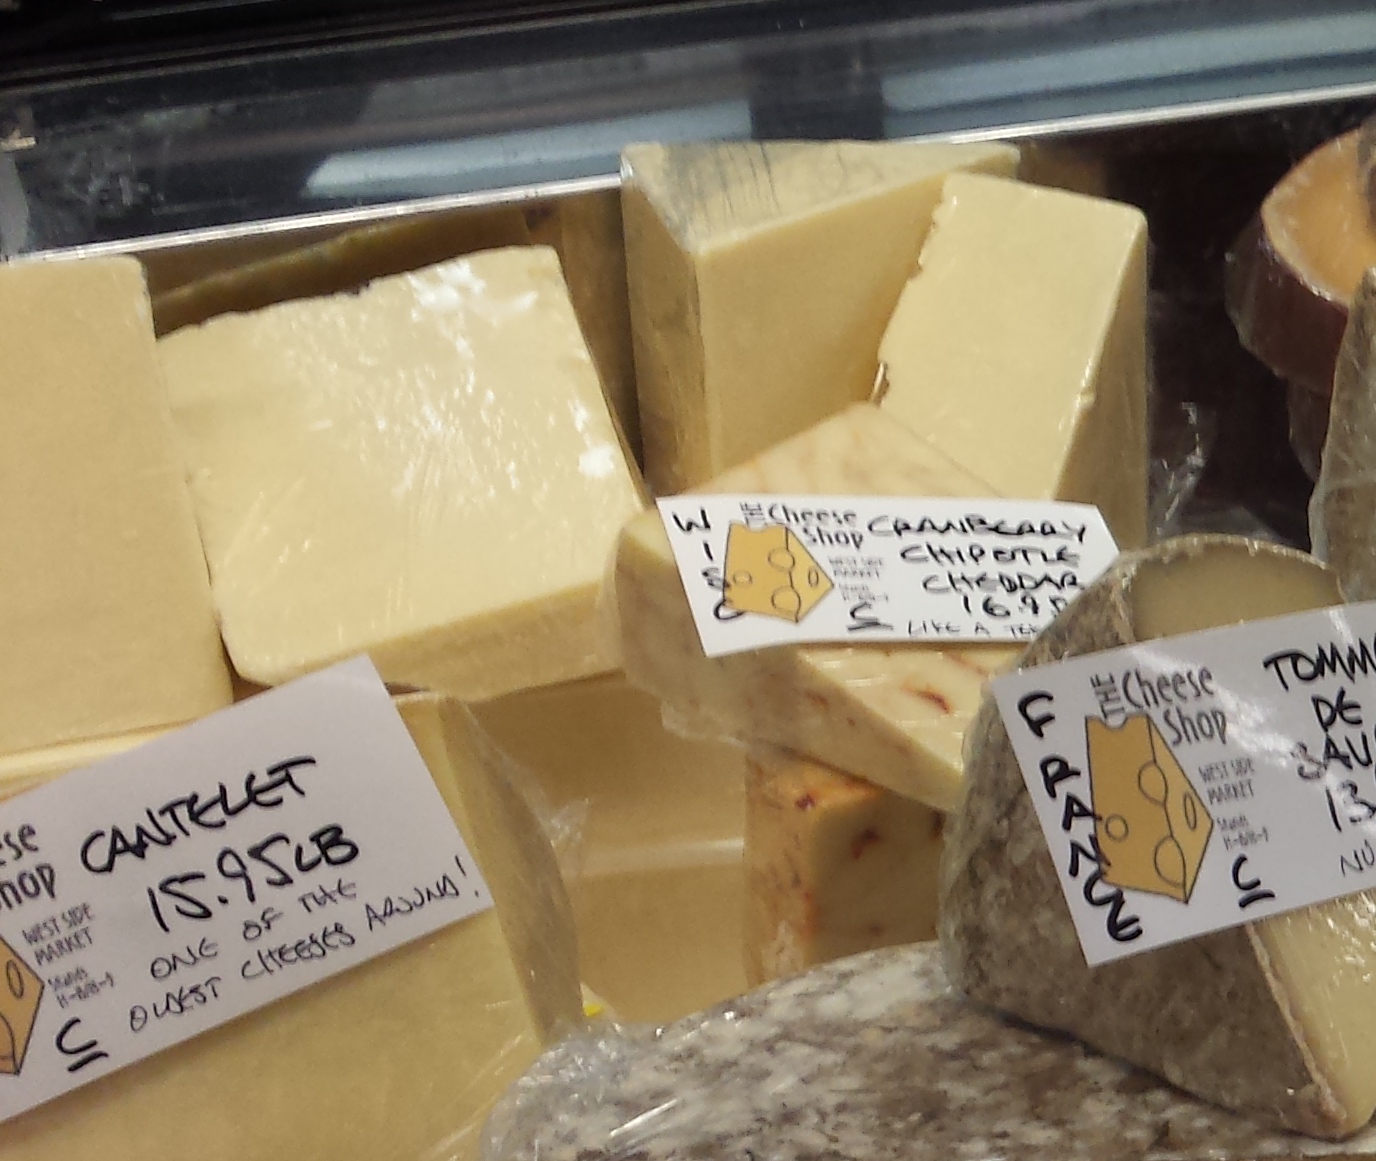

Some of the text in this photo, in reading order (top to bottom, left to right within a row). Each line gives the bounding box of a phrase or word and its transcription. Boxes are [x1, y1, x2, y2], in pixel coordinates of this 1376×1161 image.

[768, 502, 858, 526] Cheese
[867, 514, 1087, 544] CRANBERRY
[803, 525, 865, 551] Shop
[900, 543, 1081, 566] CHIPOTLE
[922, 572, 1085, 593] CHEDDAR
[974, 621, 995, 636] A
[1090, 666, 1216, 719] THE Cheese
[1311, 687, 1364, 732] DE
[1164, 704, 1229, 747] Shop
[1017, 689, 1143, 943] FRANCE
[149, 880, 358, 980] ONE OF THE
[241, 923, 356, 984] CHEESES
